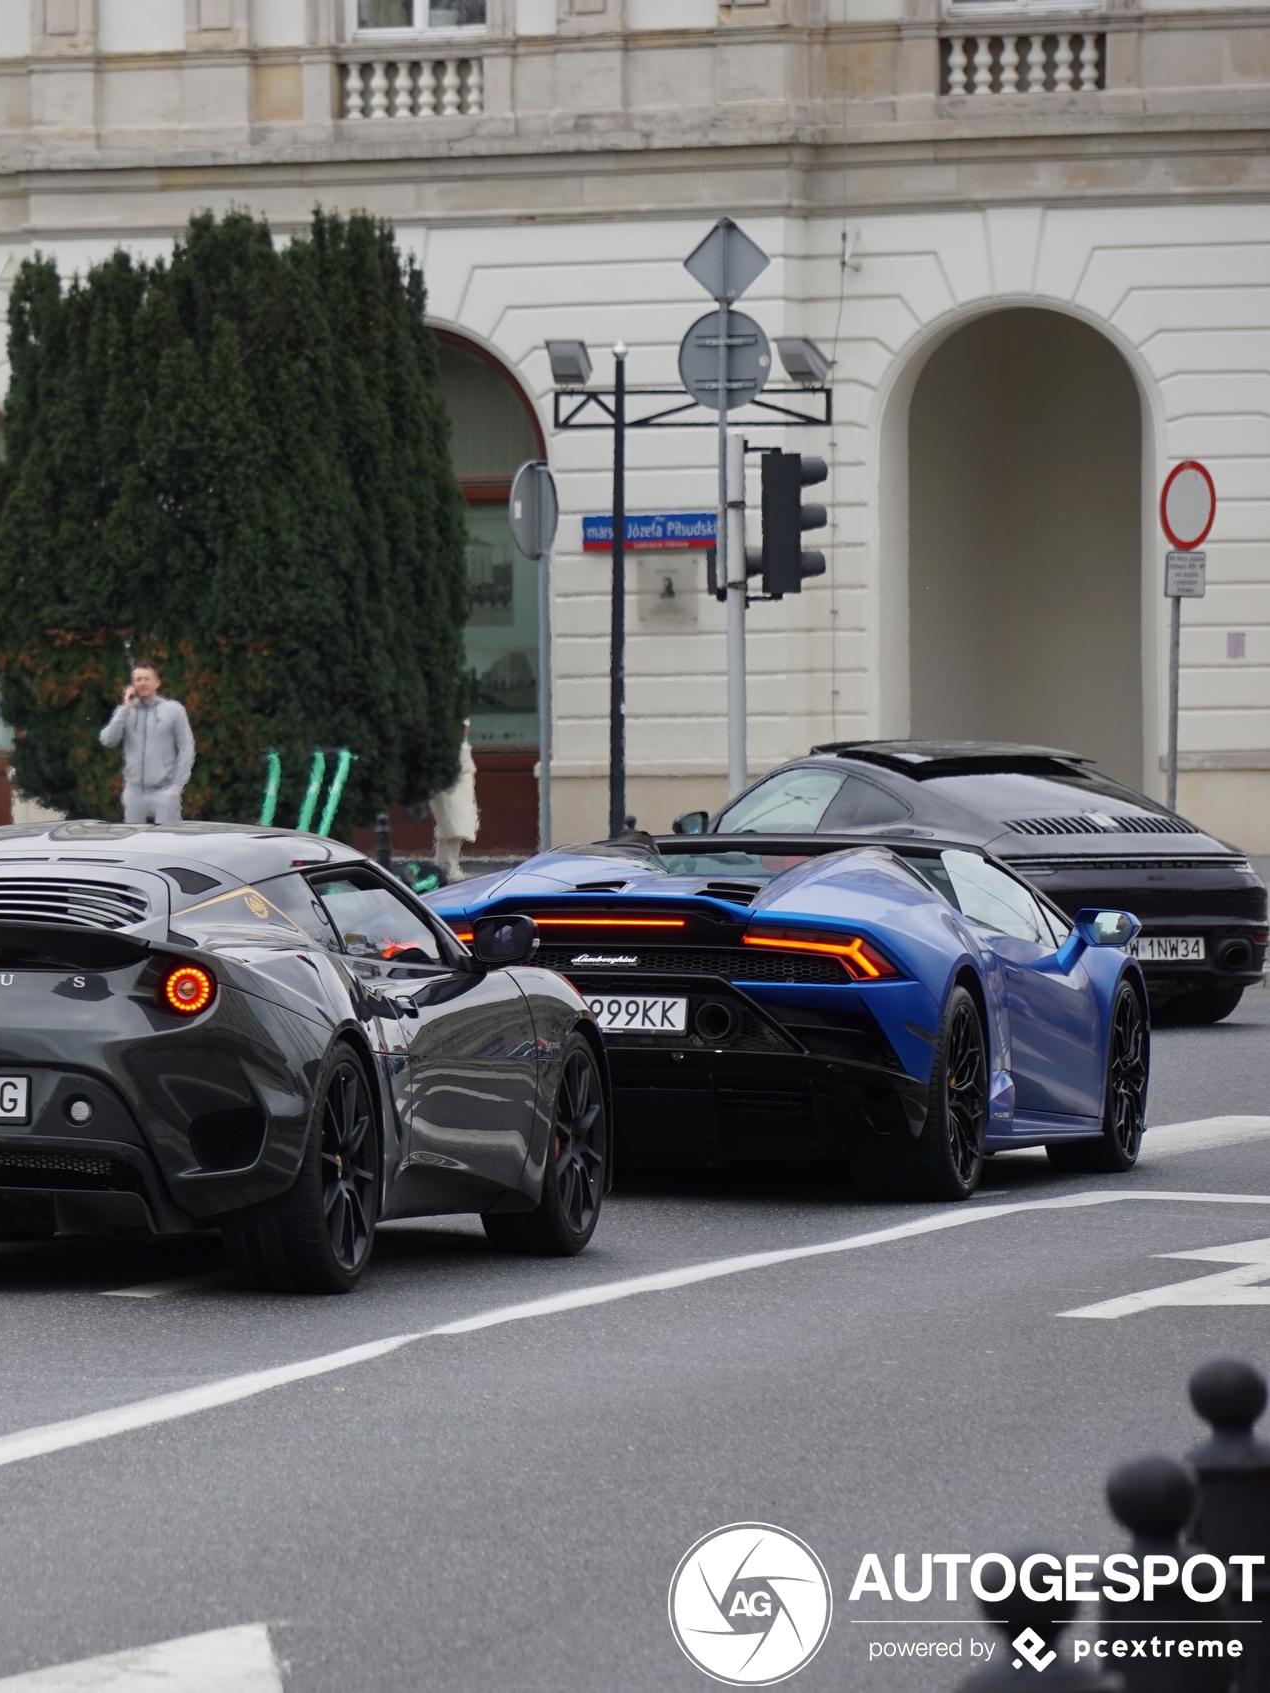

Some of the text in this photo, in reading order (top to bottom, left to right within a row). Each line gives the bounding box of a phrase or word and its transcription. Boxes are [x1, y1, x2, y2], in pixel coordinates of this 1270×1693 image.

[627, 520, 663, 539] Józefa
[1148, 939, 1201, 958] 1NW34
[570, 953, 638, 966] Lamborghini
[589, 998, 679, 1028] 999KK
